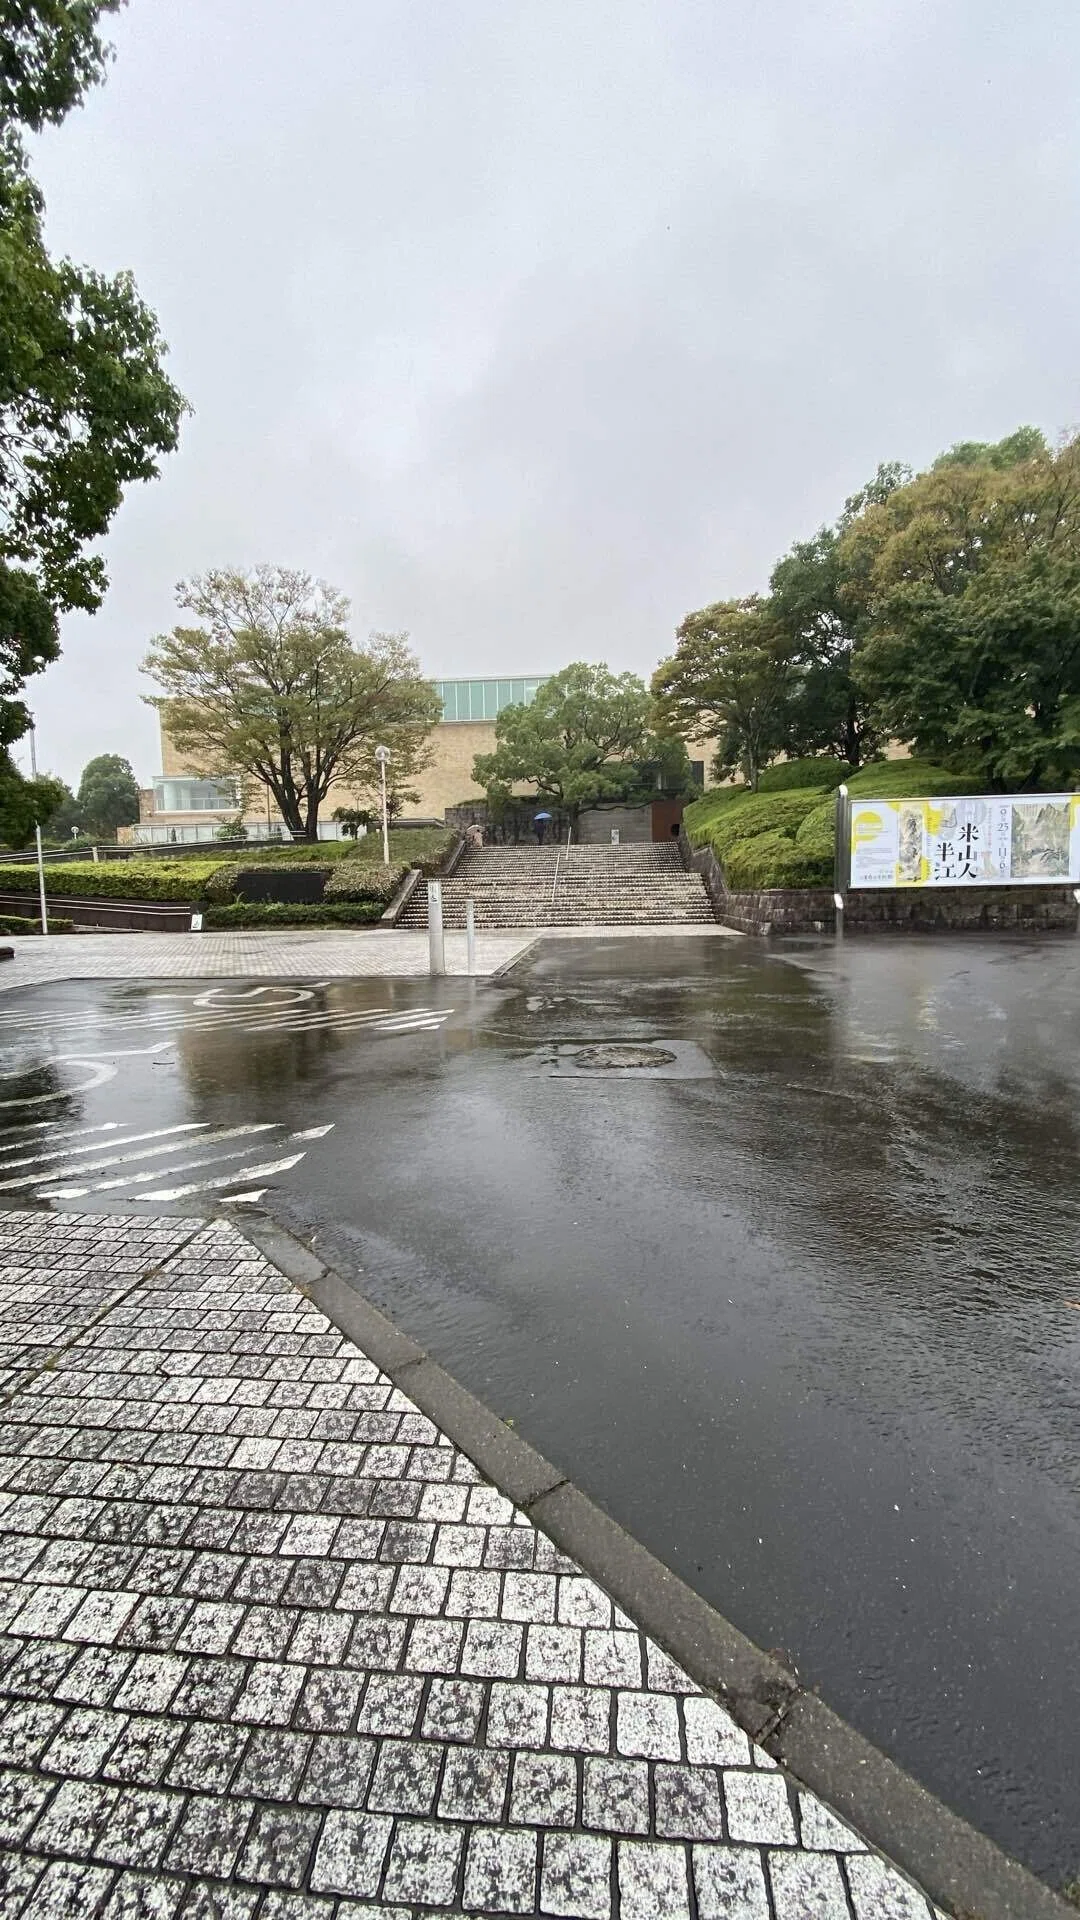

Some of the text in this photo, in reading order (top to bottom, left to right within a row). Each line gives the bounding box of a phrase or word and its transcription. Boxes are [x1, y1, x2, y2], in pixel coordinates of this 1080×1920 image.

[934, 842, 956, 880] 半江
[958, 823, 979, 879] 米山人
